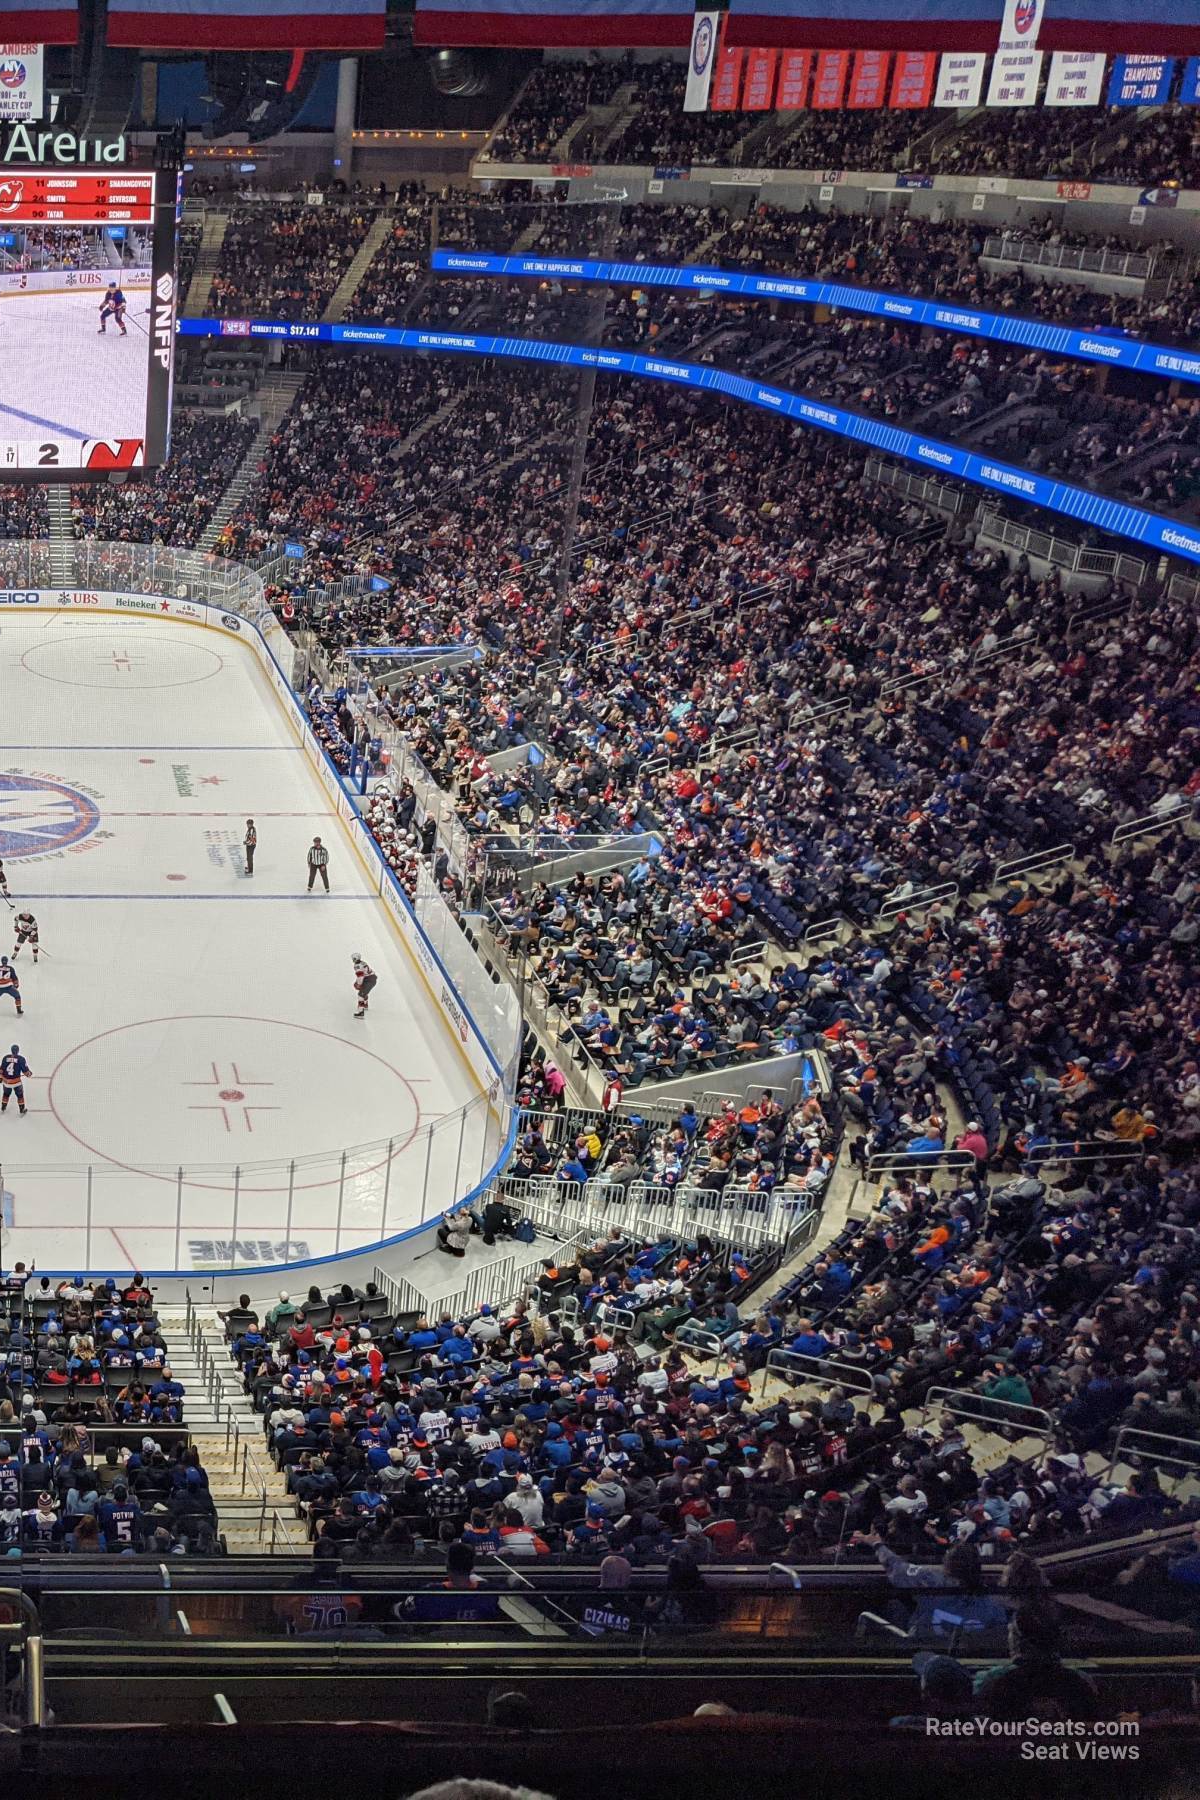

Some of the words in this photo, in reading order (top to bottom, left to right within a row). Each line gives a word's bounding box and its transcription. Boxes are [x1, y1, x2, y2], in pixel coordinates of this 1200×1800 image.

[20, 101, 33, 109] CUP
[4, 121, 126, 162] Arena
[447, 258, 489, 268] ticketmaster
[79, 274, 102, 284] UBS
[152, 304, 172, 369] NFP
[342, 330, 386, 340] ticketmaster
[1079, 339, 1122, 358] ticketmaster
[6, 451, 15, 463] 17
[38, 443, 60, 465] 2
[73, 594, 98, 605] UBS
[115, 597, 157, 610] Heineken
[6, 1063, 15, 1076] 4
[187, 1240, 311, 1262] DIME
[112, 1511, 134, 1520] POTVIN
[117, 1521, 132, 1541] 5
[302, 1604, 349, 1627] 70
[584, 1608, 631, 1630] CIZIKAS
